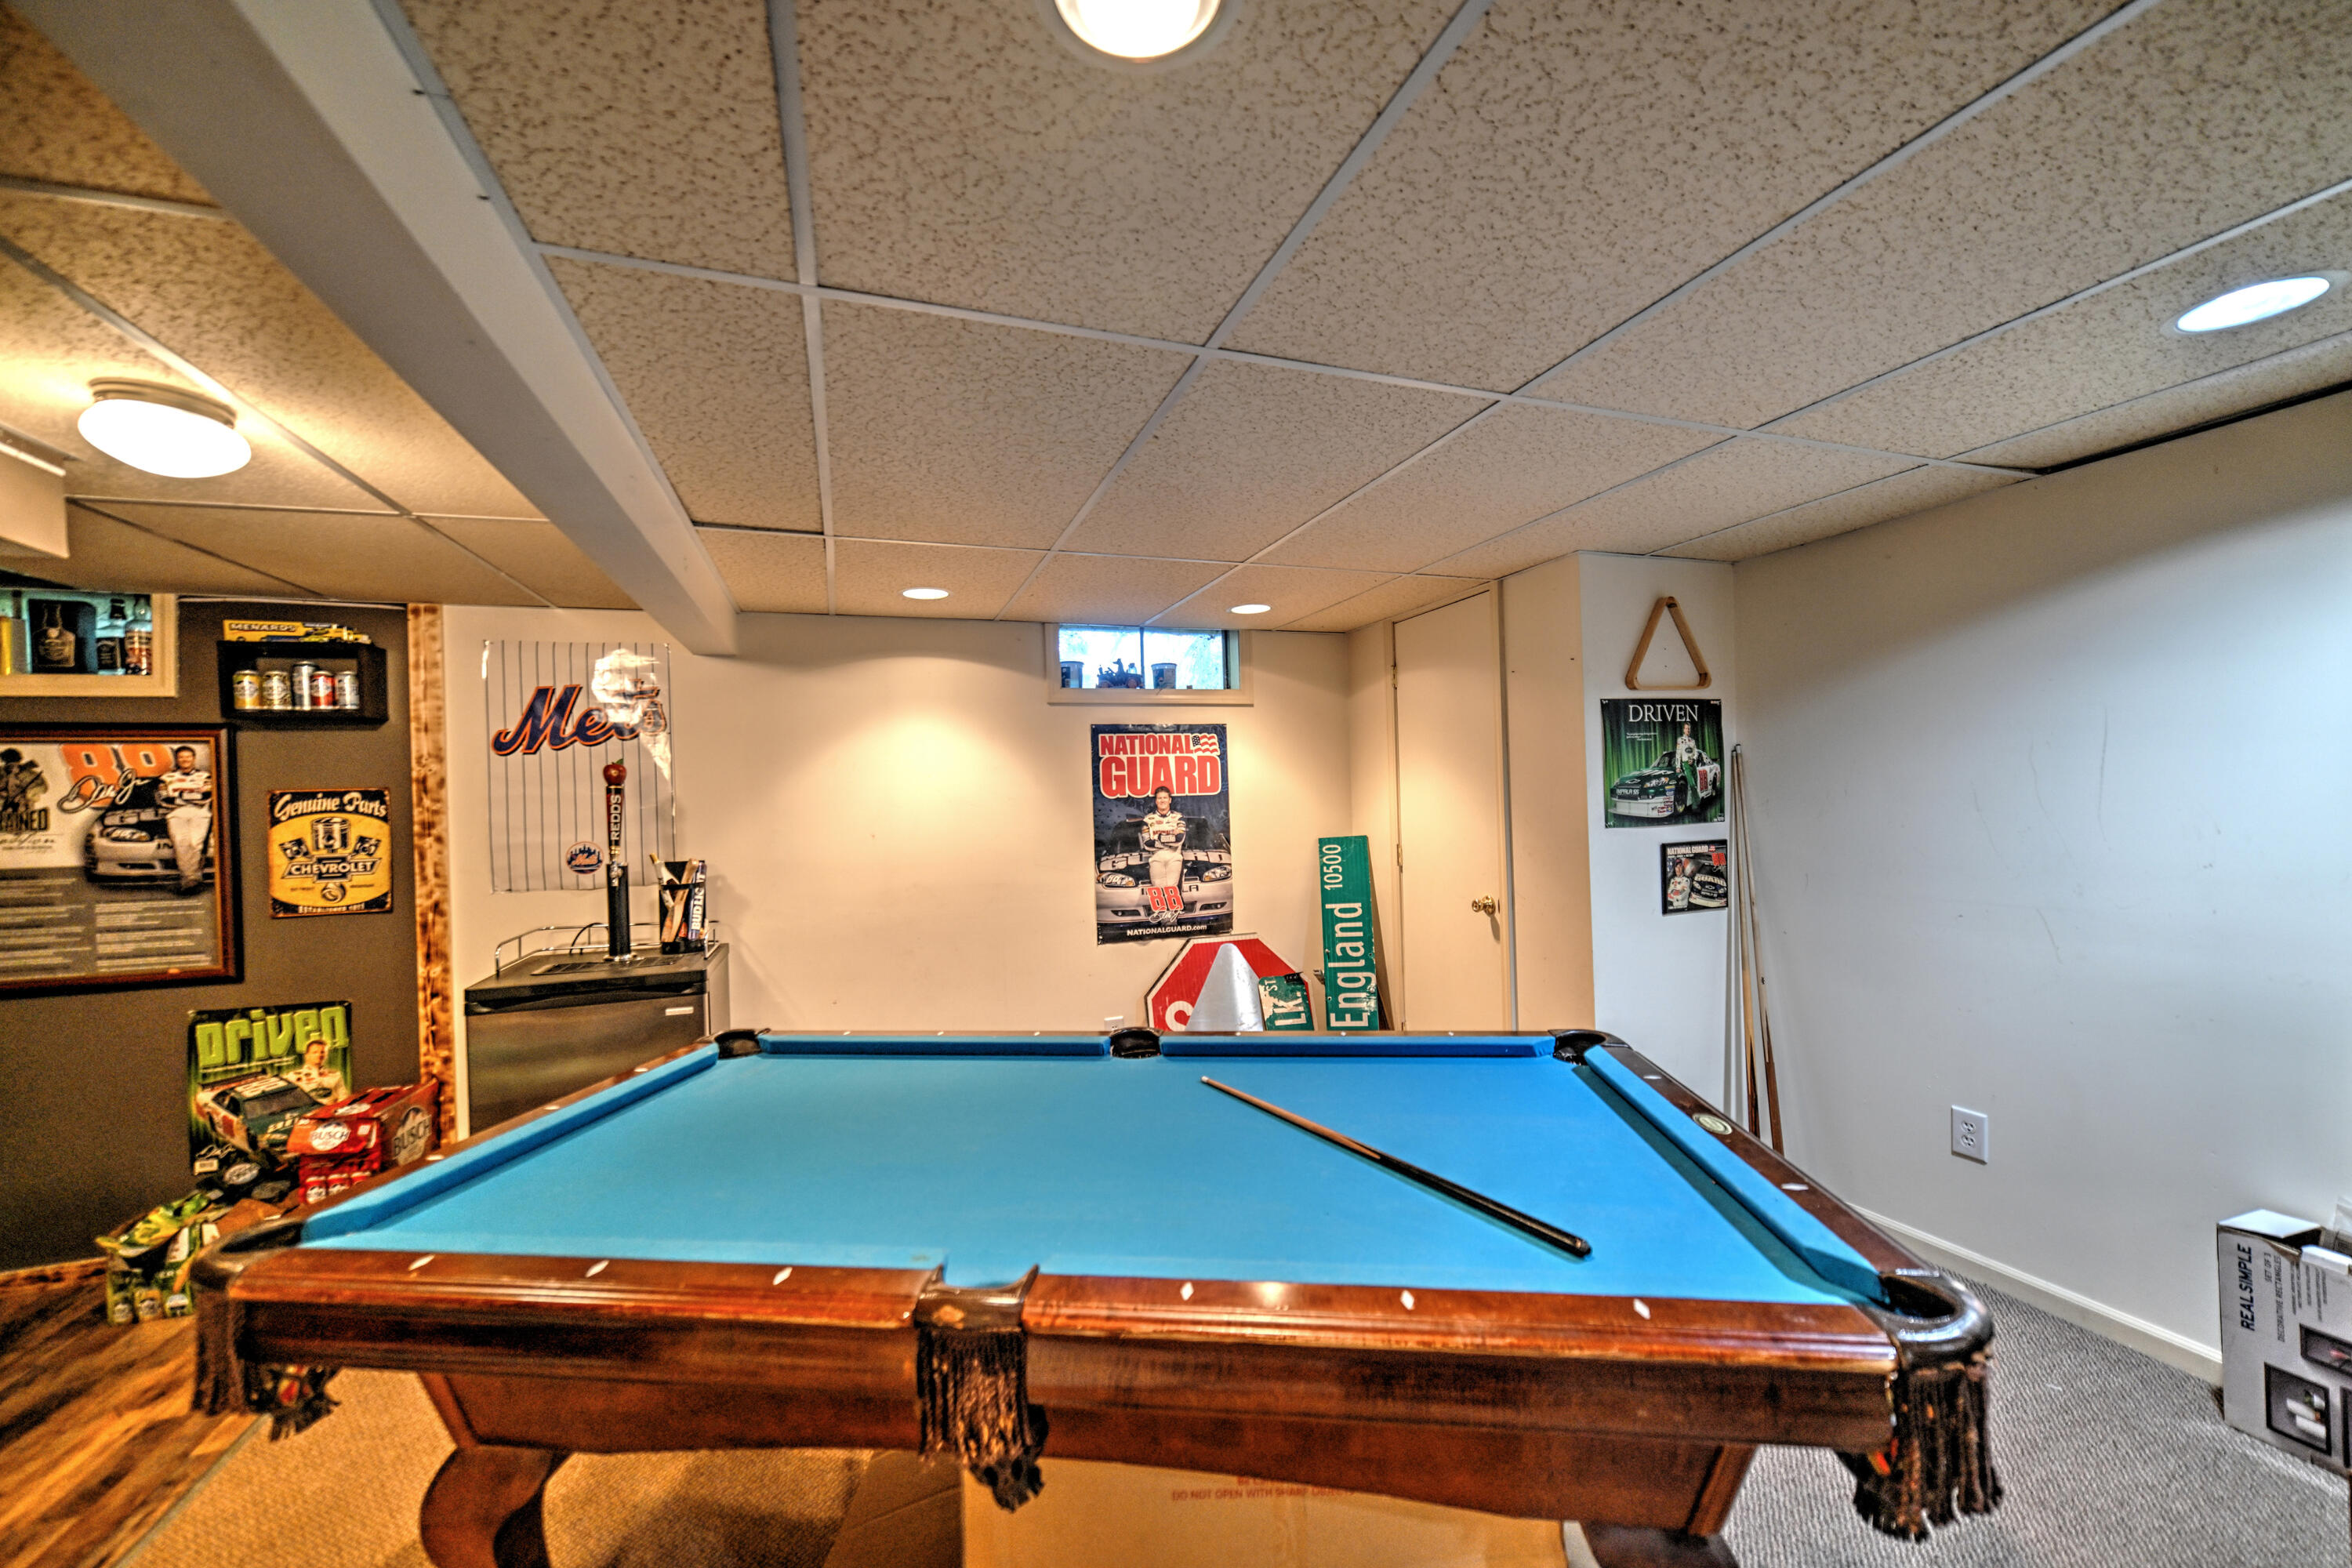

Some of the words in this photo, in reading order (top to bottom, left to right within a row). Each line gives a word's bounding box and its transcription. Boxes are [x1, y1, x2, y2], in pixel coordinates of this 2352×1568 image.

[1628, 704, 1699, 722] DRIVEN
[1100, 735, 1192, 755] NATIONAL
[1100, 754, 1221, 798] GUARD
[274, 793, 340, 822] Genuine
[343, 792, 387, 817] Parts
[290, 862, 372, 875] CHEVROLET
[1323, 844, 1343, 891] 10500
[1147, 886, 1185, 912] 88
[1126, 924, 1207, 937] NATIONALGUARD.com
[1325, 902, 1377, 1027] England
[393, 1116, 432, 1160] BUSCH
[1247, 1488, 1273, 1498] WITH
